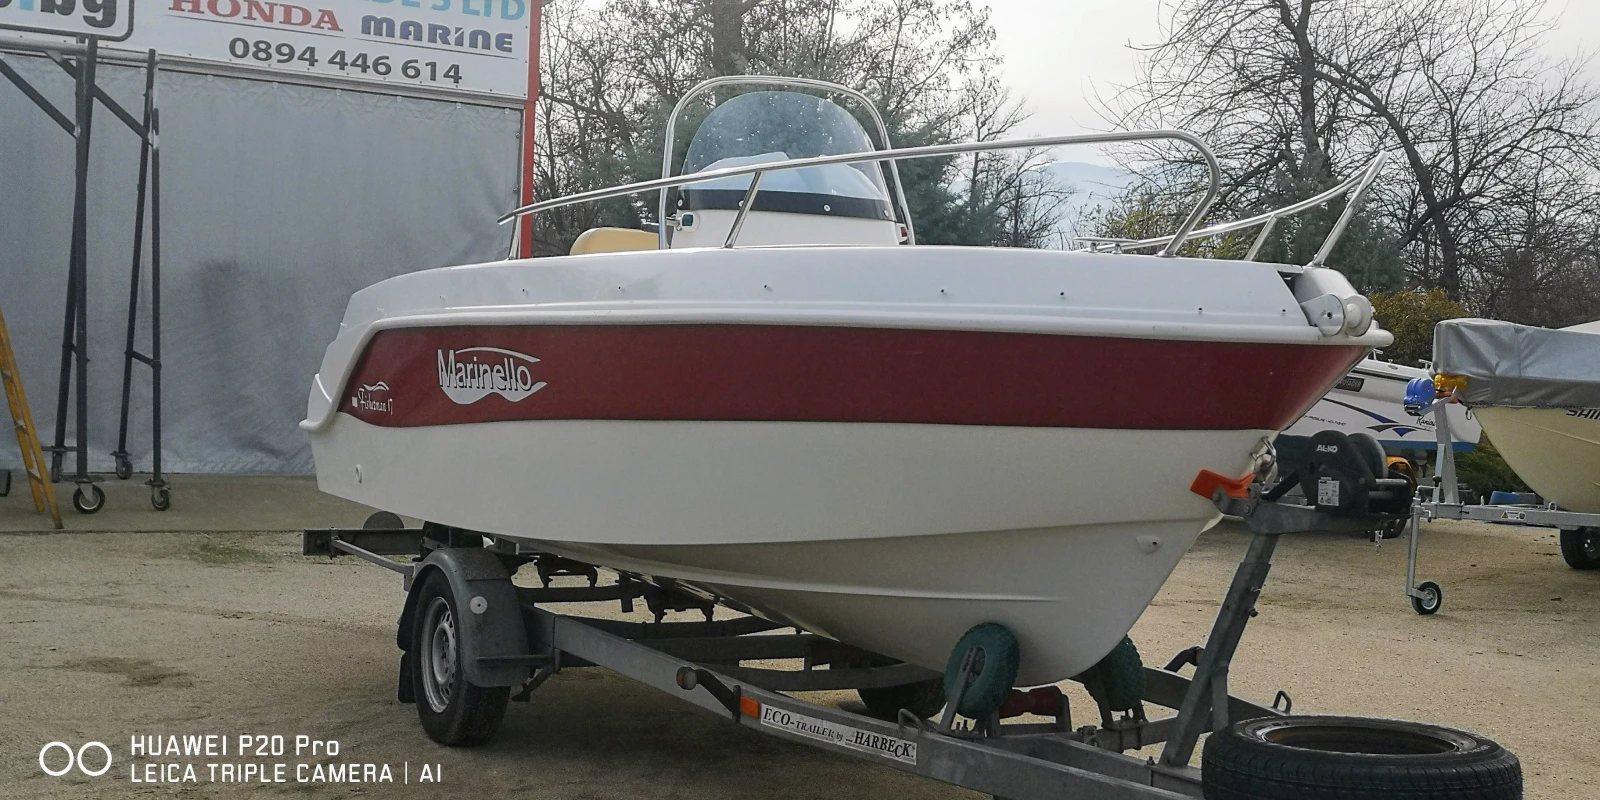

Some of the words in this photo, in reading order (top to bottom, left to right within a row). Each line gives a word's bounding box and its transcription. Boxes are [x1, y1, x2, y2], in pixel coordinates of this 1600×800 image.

[168, 0, 344, 32] HONDA
[228, 37, 319, 67] 0894
[327, 49, 392, 76] 446
[401, 59, 463, 84] 614
[437, 348, 533, 392] Marinello
[1316, 444, 1338, 453] AL-KO
[836, 731, 844, 742] by
